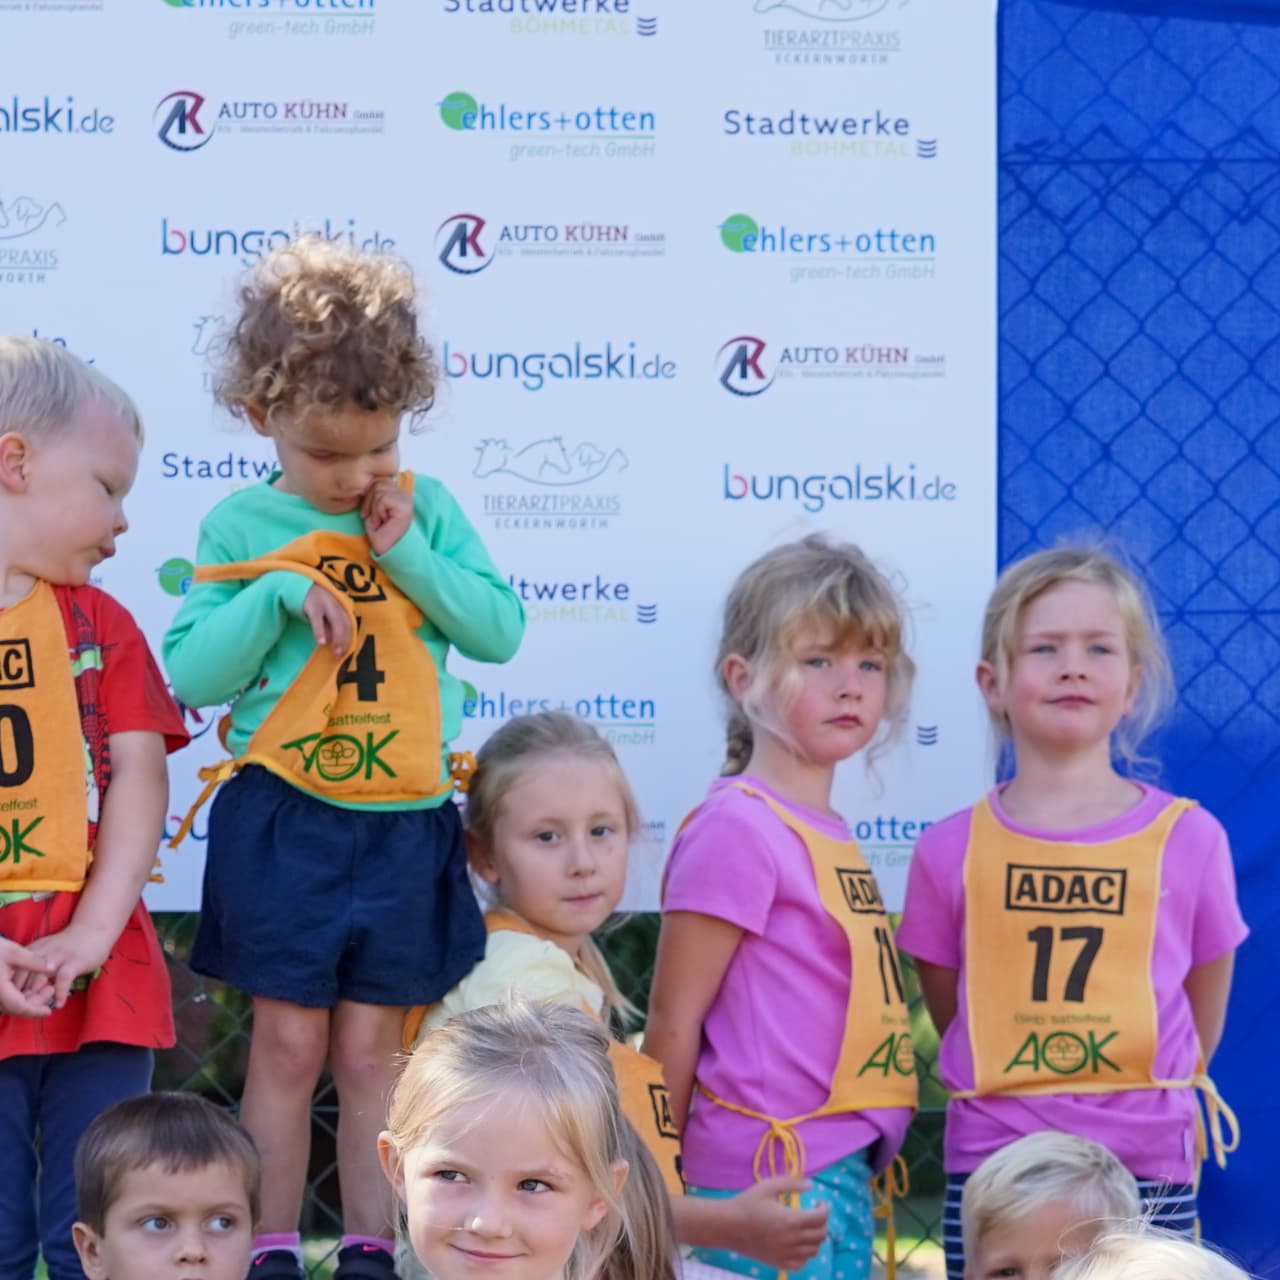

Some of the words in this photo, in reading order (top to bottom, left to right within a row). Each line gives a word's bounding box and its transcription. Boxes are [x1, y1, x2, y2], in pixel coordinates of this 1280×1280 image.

[218, 102, 278, 119] AUTO
[284, 100, 348, 119] KÜHN
[462, 104, 656, 131] ehlers+otten
[724, 109, 911, 136] Stadtwerke
[499, 225, 559, 242] AUTO
[565, 222, 630, 242] KÜHN
[743, 226, 937, 253] ehlers+otten
[442, 341, 677, 392] bungalski.de
[779, 347, 839, 364] AUTO
[845, 344, 909, 364] KÜHN
[723, 463, 958, 513] bungalski.de
[483, 494, 621, 513] TIERARZTPRAXIS
[1015, 872, 1116, 906] ADAC
[1027, 925, 1105, 1004] 17
[1003, 1029, 1123, 1075] AOK
